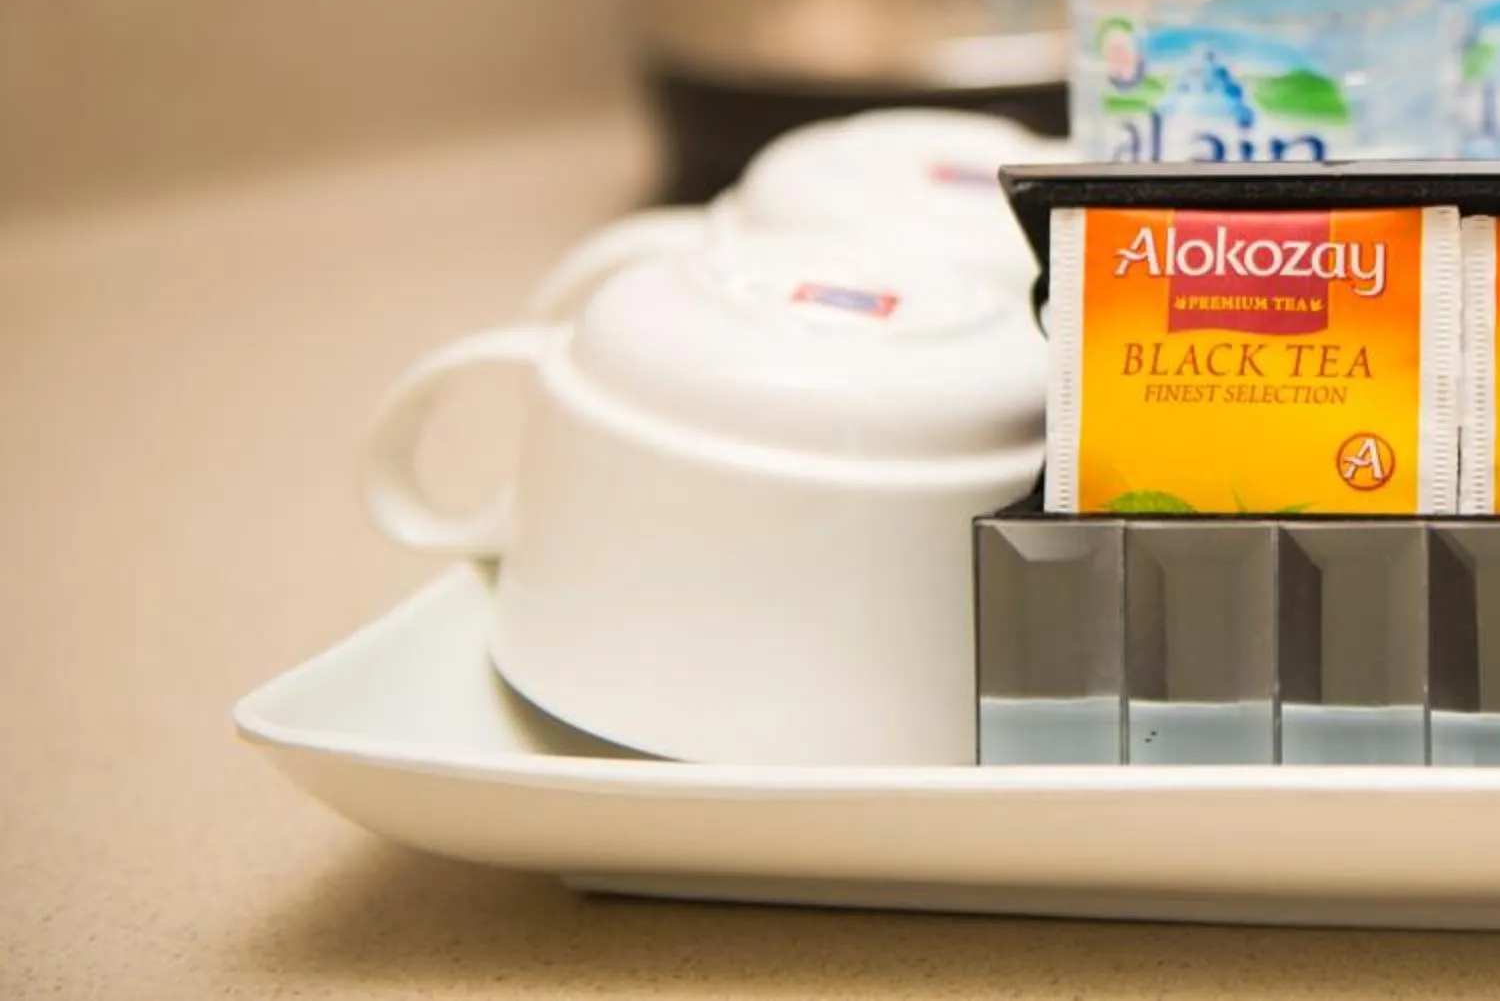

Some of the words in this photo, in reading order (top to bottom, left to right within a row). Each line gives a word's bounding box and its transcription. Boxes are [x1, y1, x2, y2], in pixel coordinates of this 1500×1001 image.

[1114, 226, 1387, 296] Alokozay
[1185, 296, 1268, 312] PREMIUM
[1274, 297, 1309, 312] TEA
[1121, 342, 1265, 377] BLACK
[1286, 344, 1374, 379] TEA
[1144, 384, 1222, 404] FINEST
[1224, 384, 1348, 405] SELECTION
[1342, 438, 1384, 481] A
